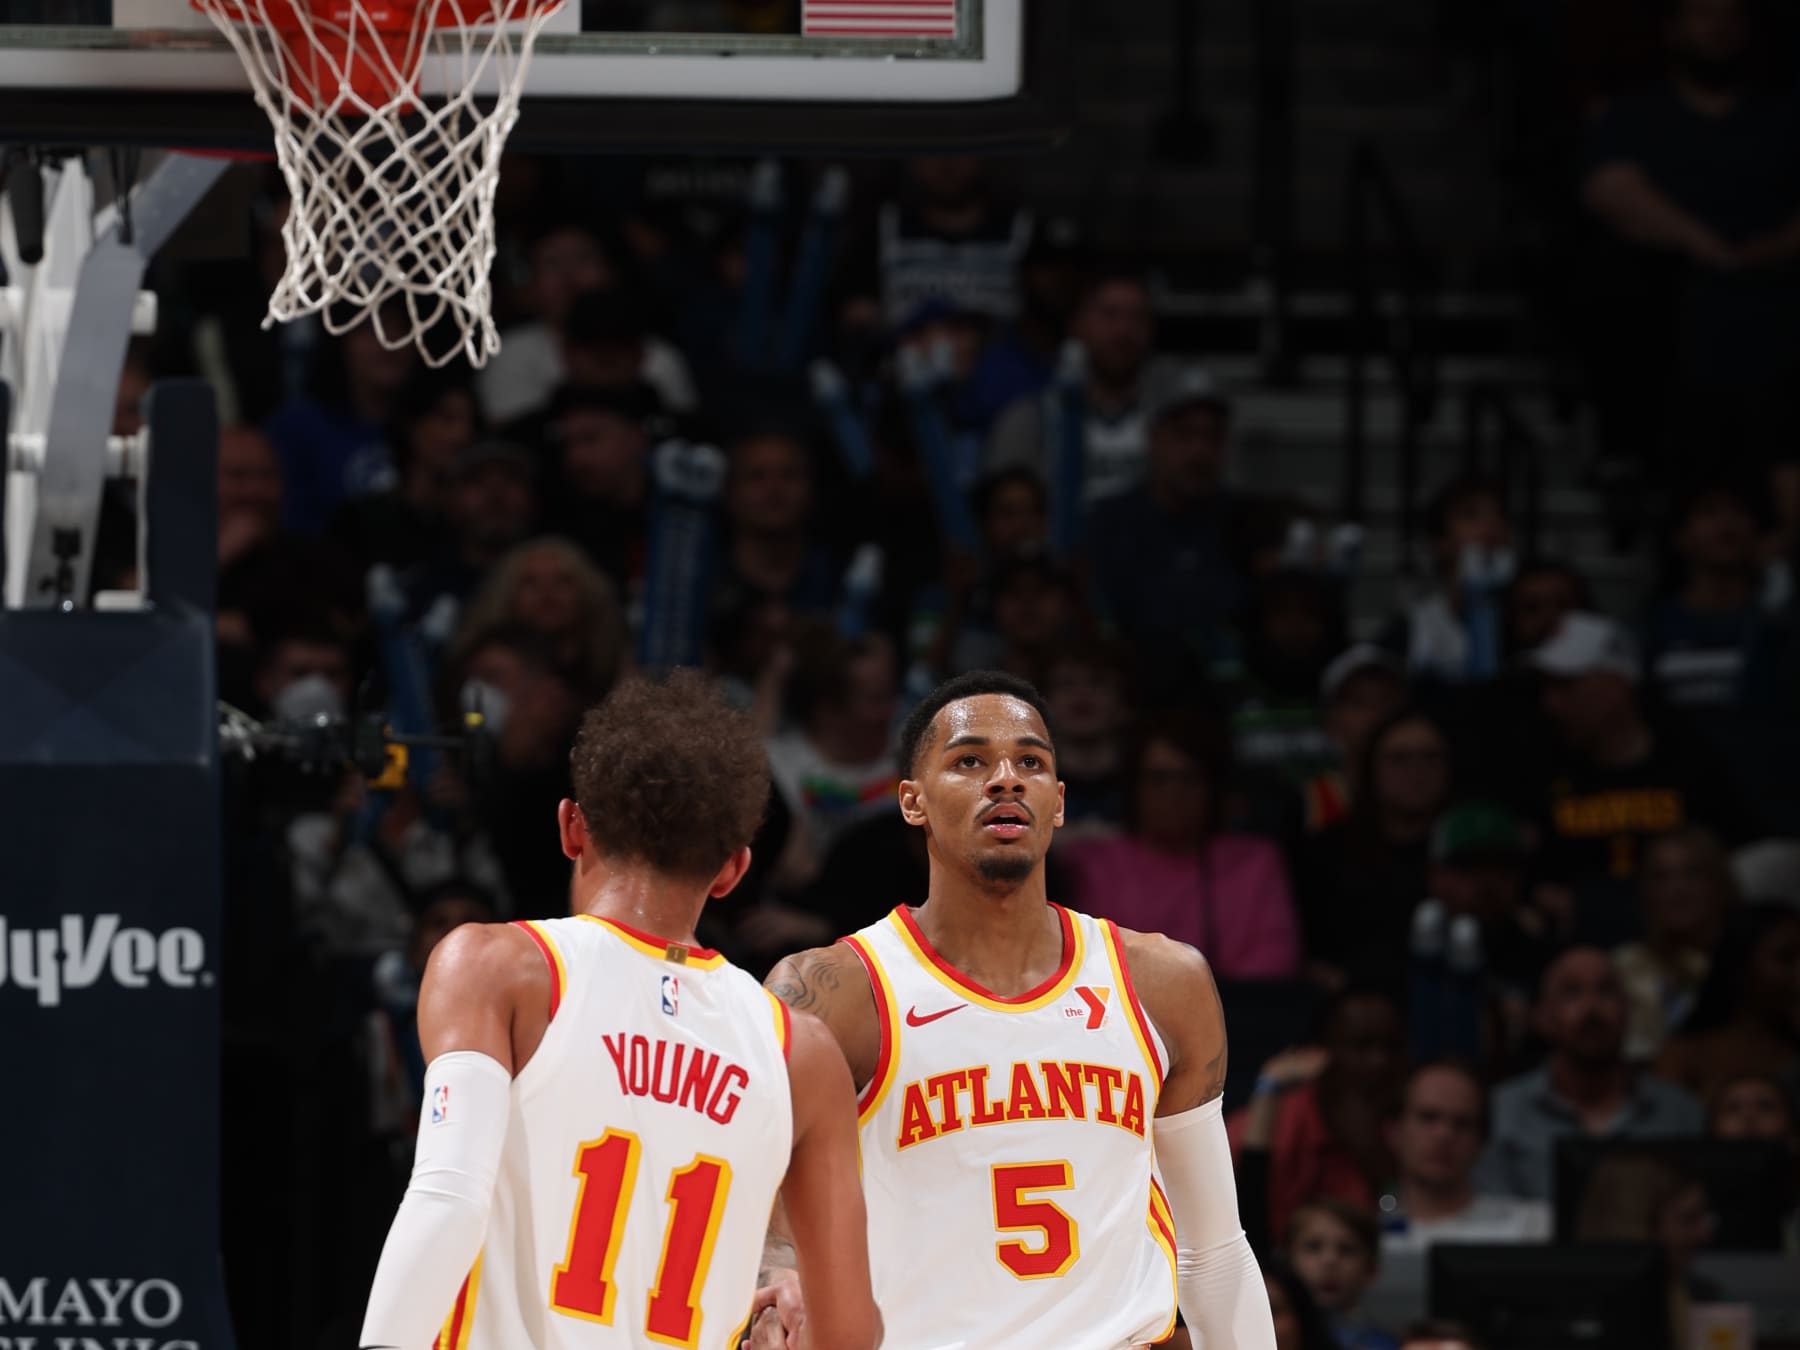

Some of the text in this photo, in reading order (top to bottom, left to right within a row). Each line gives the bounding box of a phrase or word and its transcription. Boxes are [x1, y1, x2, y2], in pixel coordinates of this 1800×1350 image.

[0, 914, 213, 1006] yVee.
[1064, 1007, 1085, 1018] the
[602, 1032, 749, 1126] YOUNG
[896, 1060, 1146, 1152] ATLANTA
[990, 1159, 1081, 1281] 5
[0, 1276, 183, 1328] MAYO
